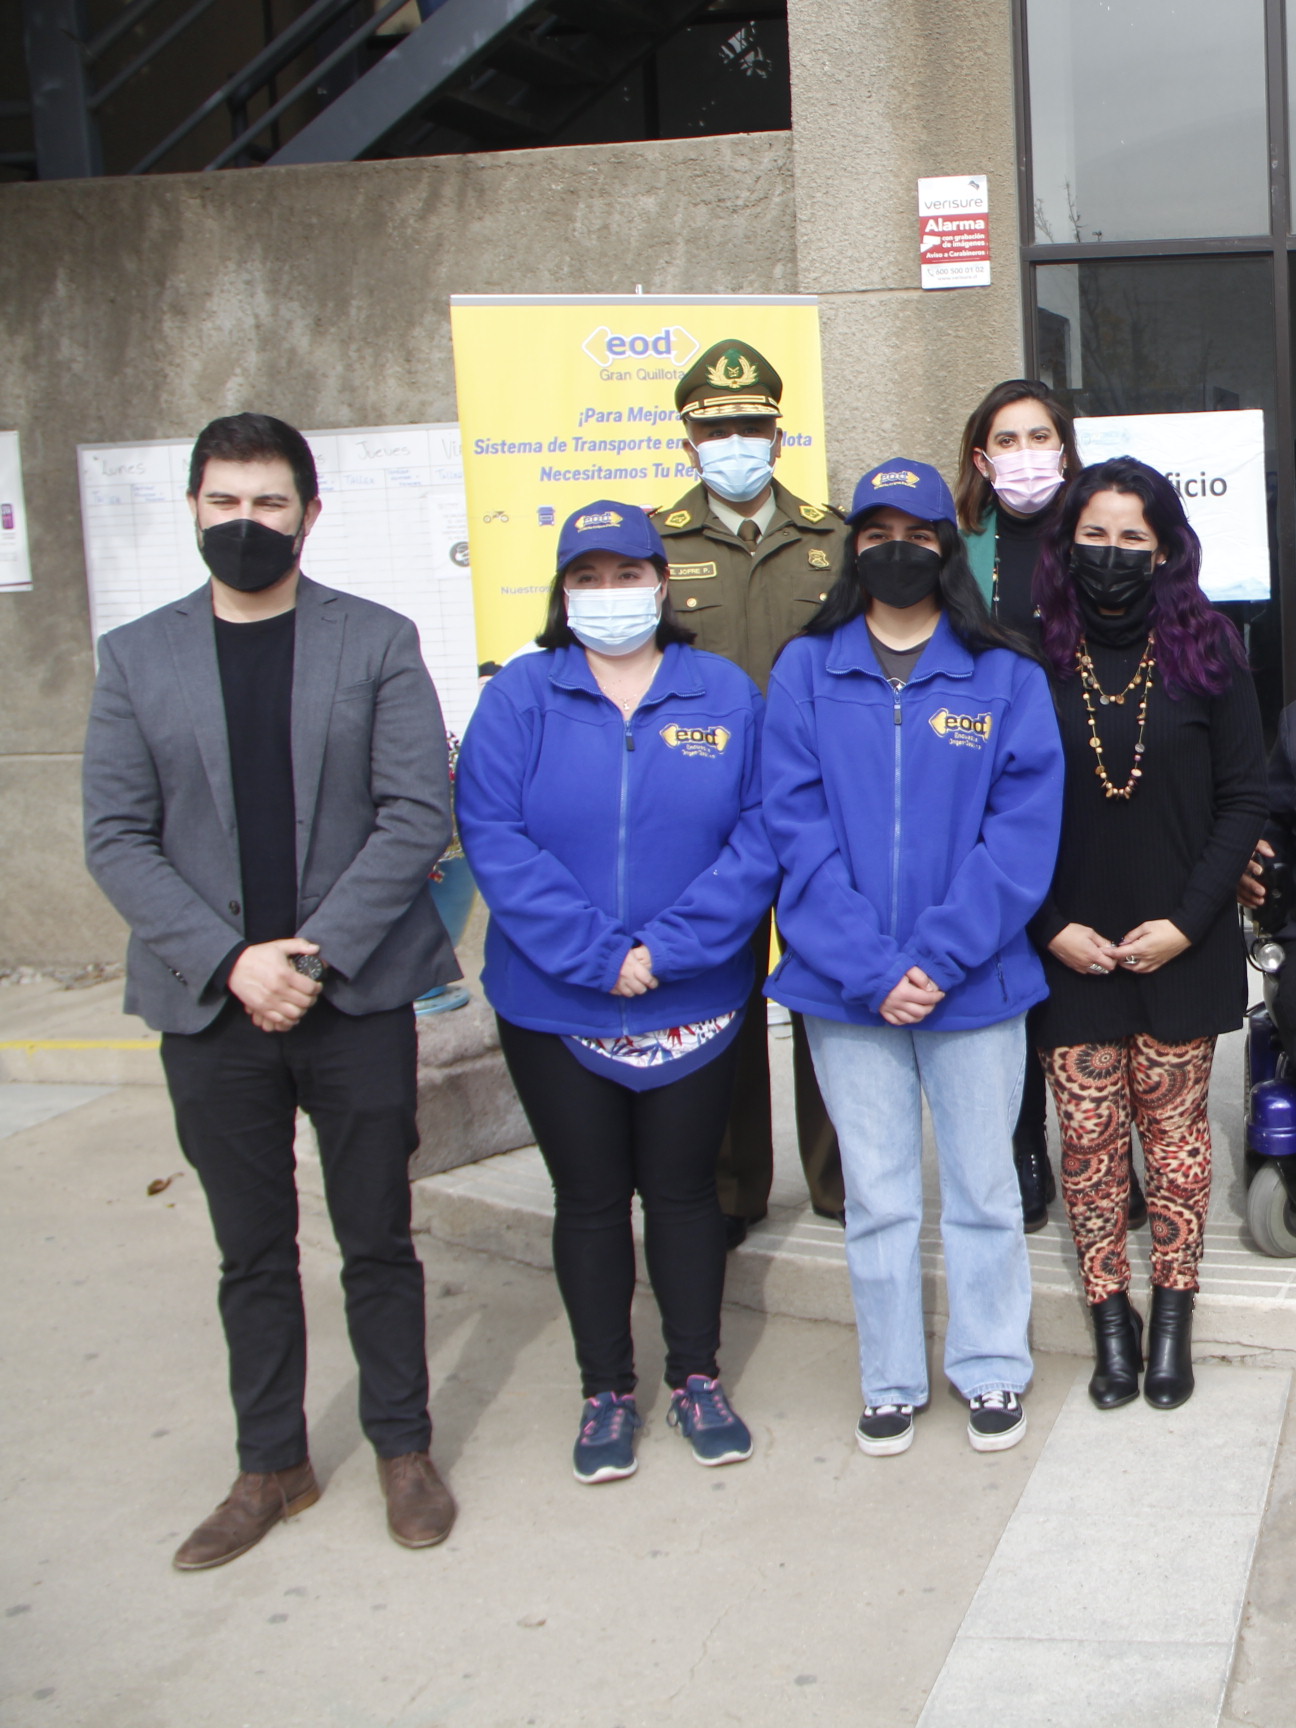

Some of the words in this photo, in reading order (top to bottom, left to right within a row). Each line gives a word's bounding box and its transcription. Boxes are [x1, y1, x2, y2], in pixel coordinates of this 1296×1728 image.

[924, 198, 983, 210] verisure
[925, 217, 985, 232] Alarma
[953, 240, 985, 248] imágenes
[954, 233, 985, 242] grabación
[926, 251, 942, 259] Aviso
[606, 329, 671, 356] eod
[600, 368, 632, 381] Gran
[636, 368, 686, 381] Quillota
[578, 407, 622, 428] ¡Para
[355, 440, 411, 460] Jueves
[474, 438, 543, 455] Sistema
[547, 437, 567, 453] de
[572, 436, 662, 456] Transporte
[540, 465, 647, 482] Necesitamos
[652, 463, 670, 478] Tu
[945, 716, 985, 733] eod
[676, 729, 716, 746] eod
